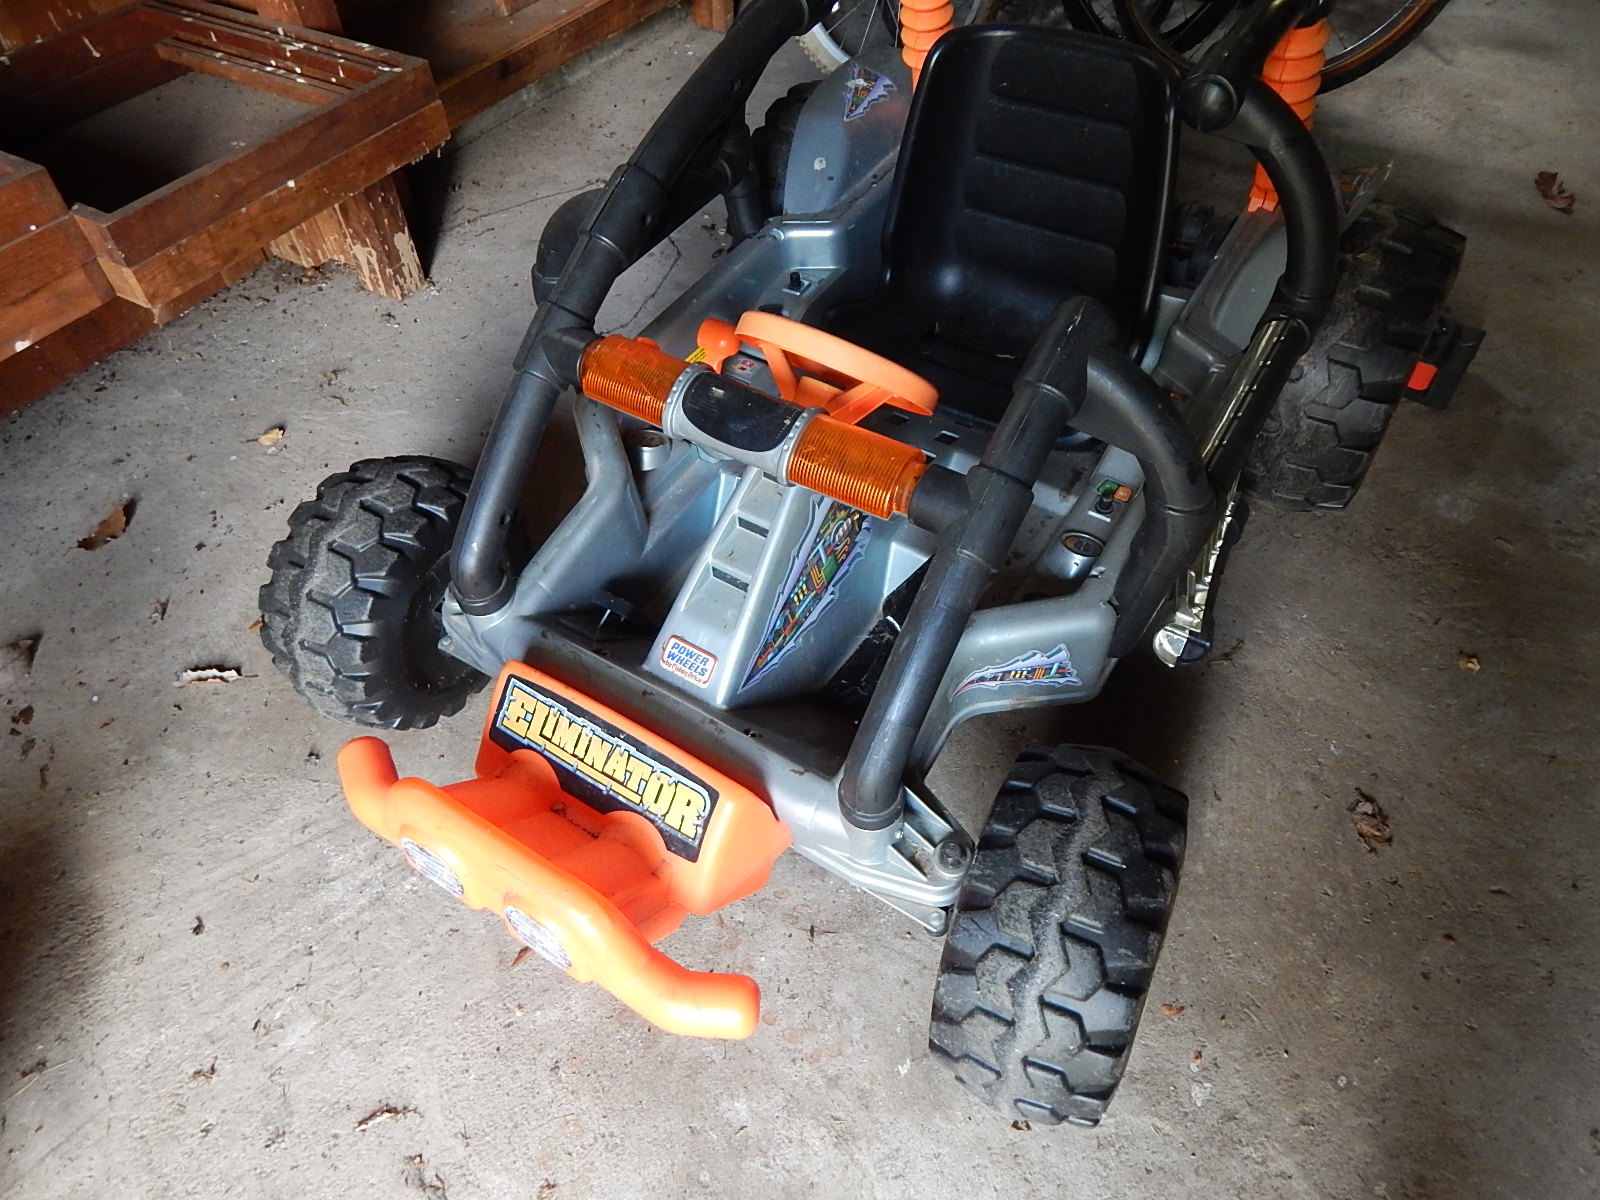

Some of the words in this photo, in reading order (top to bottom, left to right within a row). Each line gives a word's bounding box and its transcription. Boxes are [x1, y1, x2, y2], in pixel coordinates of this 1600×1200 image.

[666, 650, 708, 677] WHEELS
[670, 641, 710, 667] POWER
[501, 684, 708, 841] ELIMINATOR
